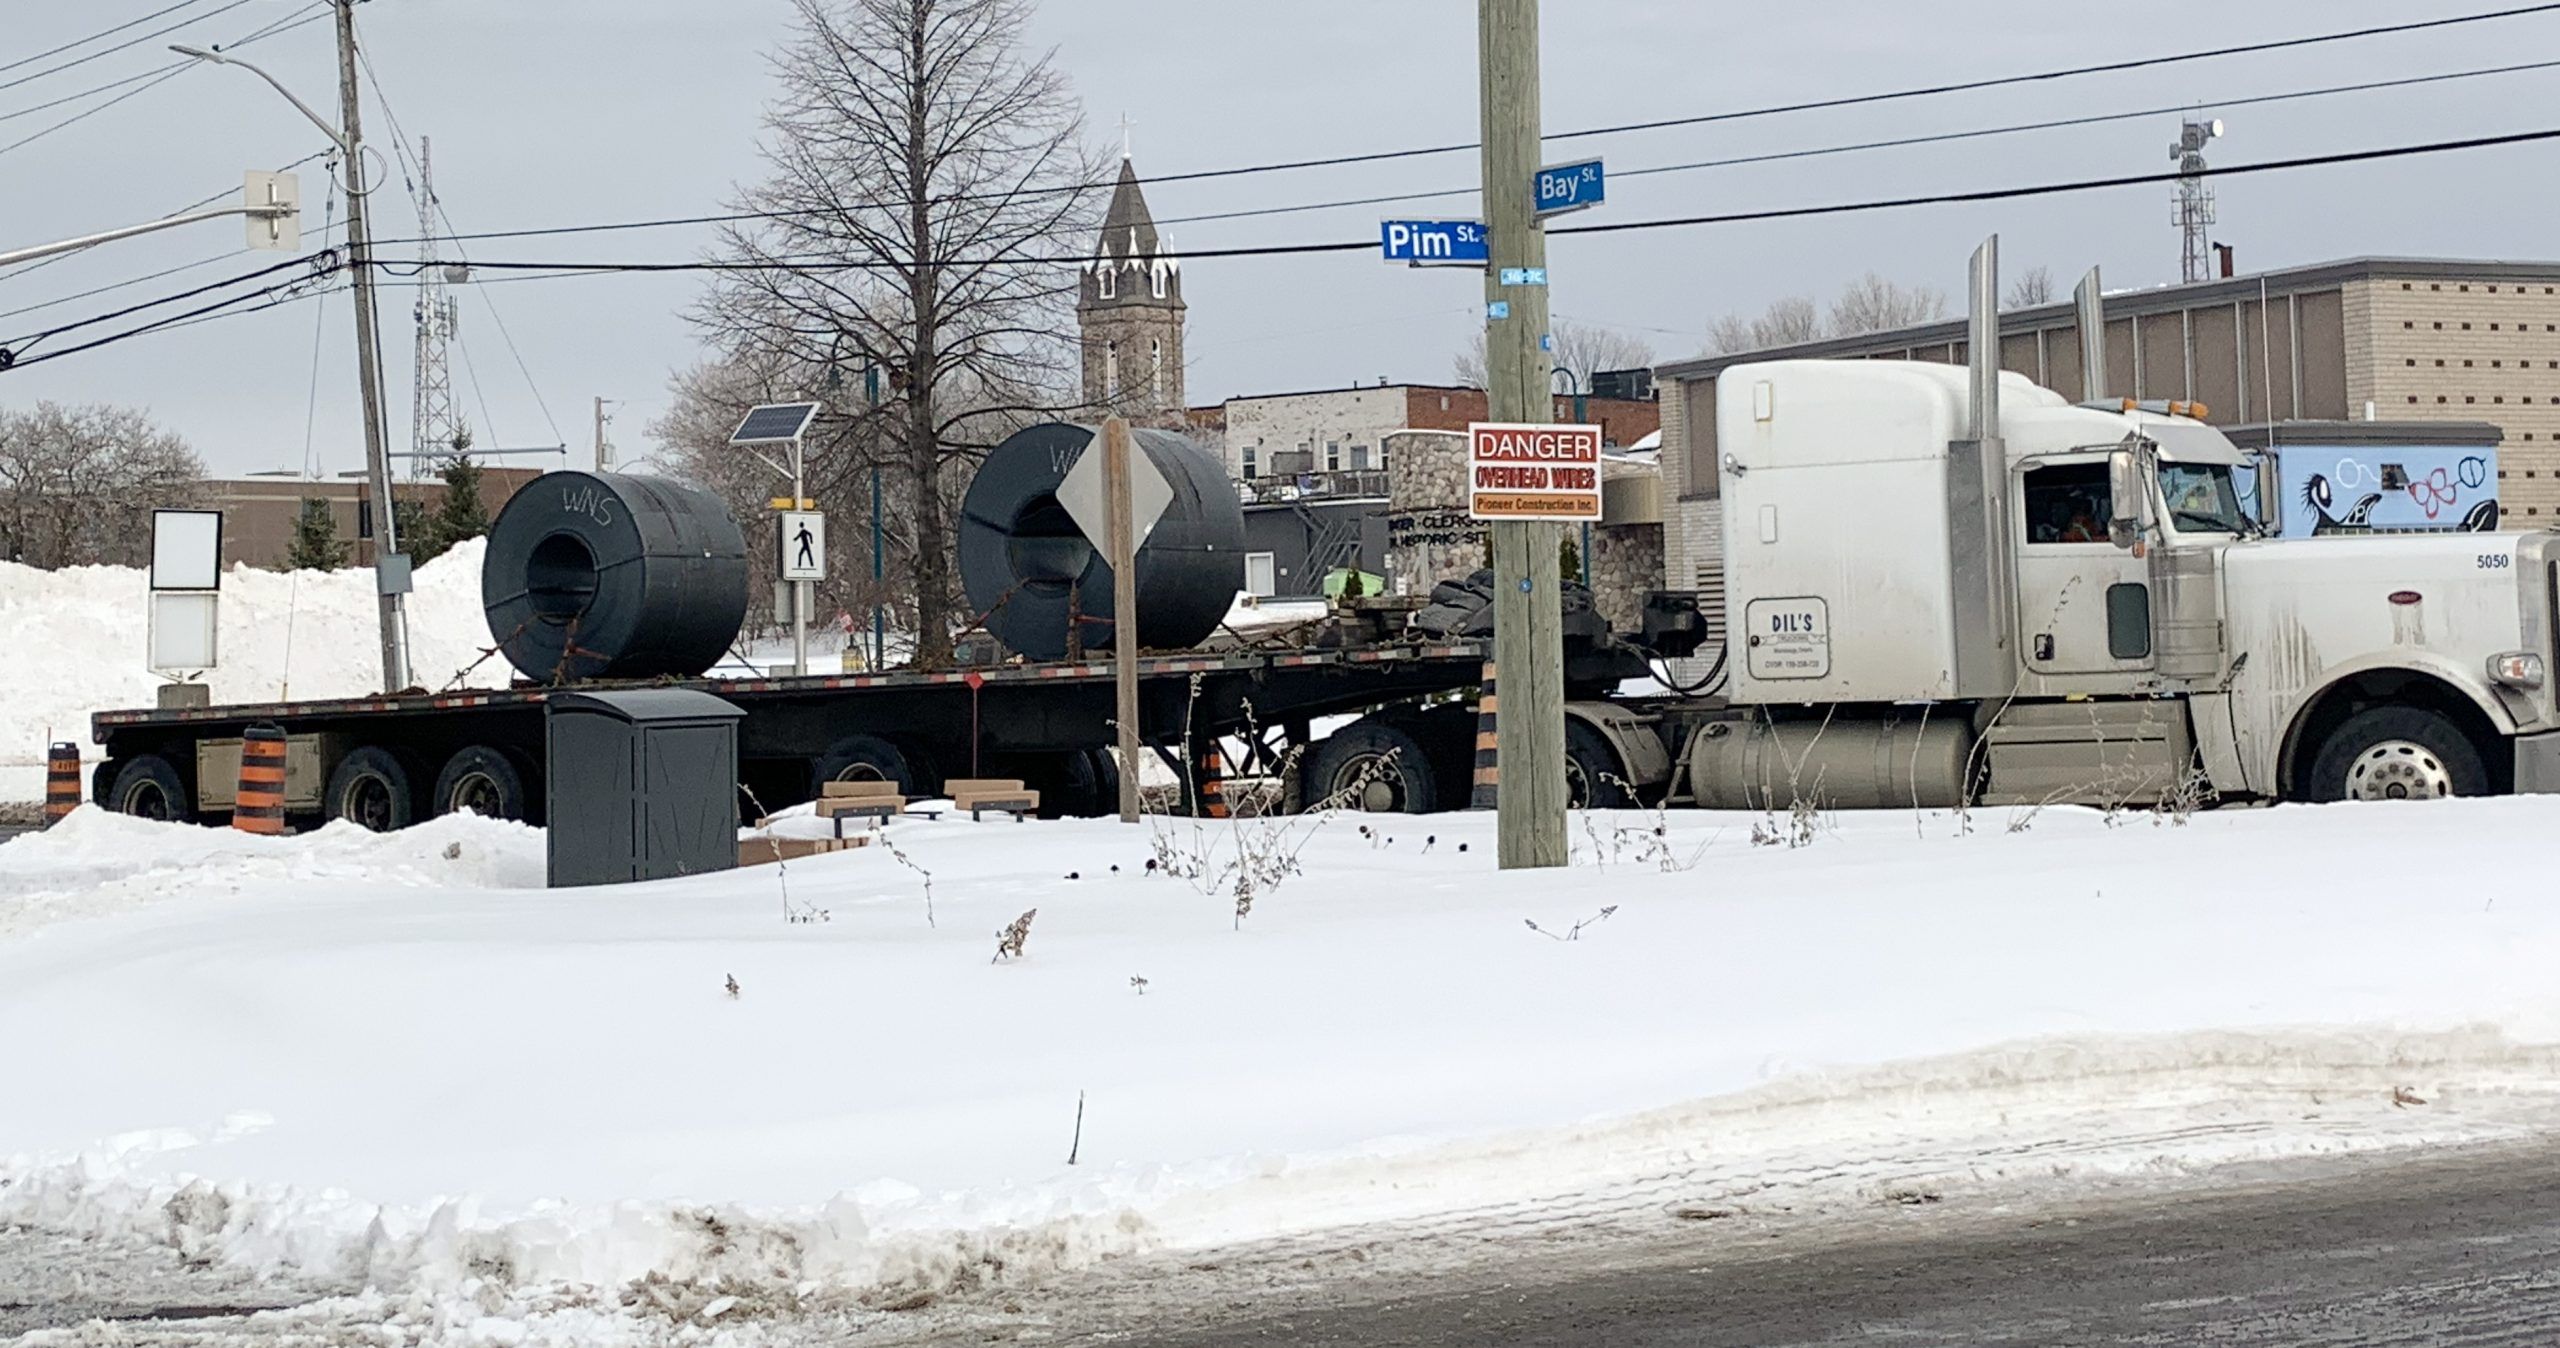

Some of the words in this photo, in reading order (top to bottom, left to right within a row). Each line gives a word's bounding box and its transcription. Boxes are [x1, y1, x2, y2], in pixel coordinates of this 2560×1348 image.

[1541, 174, 1579, 202] Bay
[1388, 225, 1451, 256] Pim
[1457, 225, 1480, 243] St.
[1478, 433, 1592, 459] DANGER
[1475, 466, 1548, 489] OVERHEAD
[1551, 467, 1596, 490] WIRES
[563, 485, 617, 526] WNS
[1477, 498, 1513, 510] Pioneer
[1516, 498, 1575, 510] Construction
[1577, 499, 1593, 510] Inc.
[2477, 554, 2509, 569] 5050
[1772, 613, 1812, 632] DIL'S
